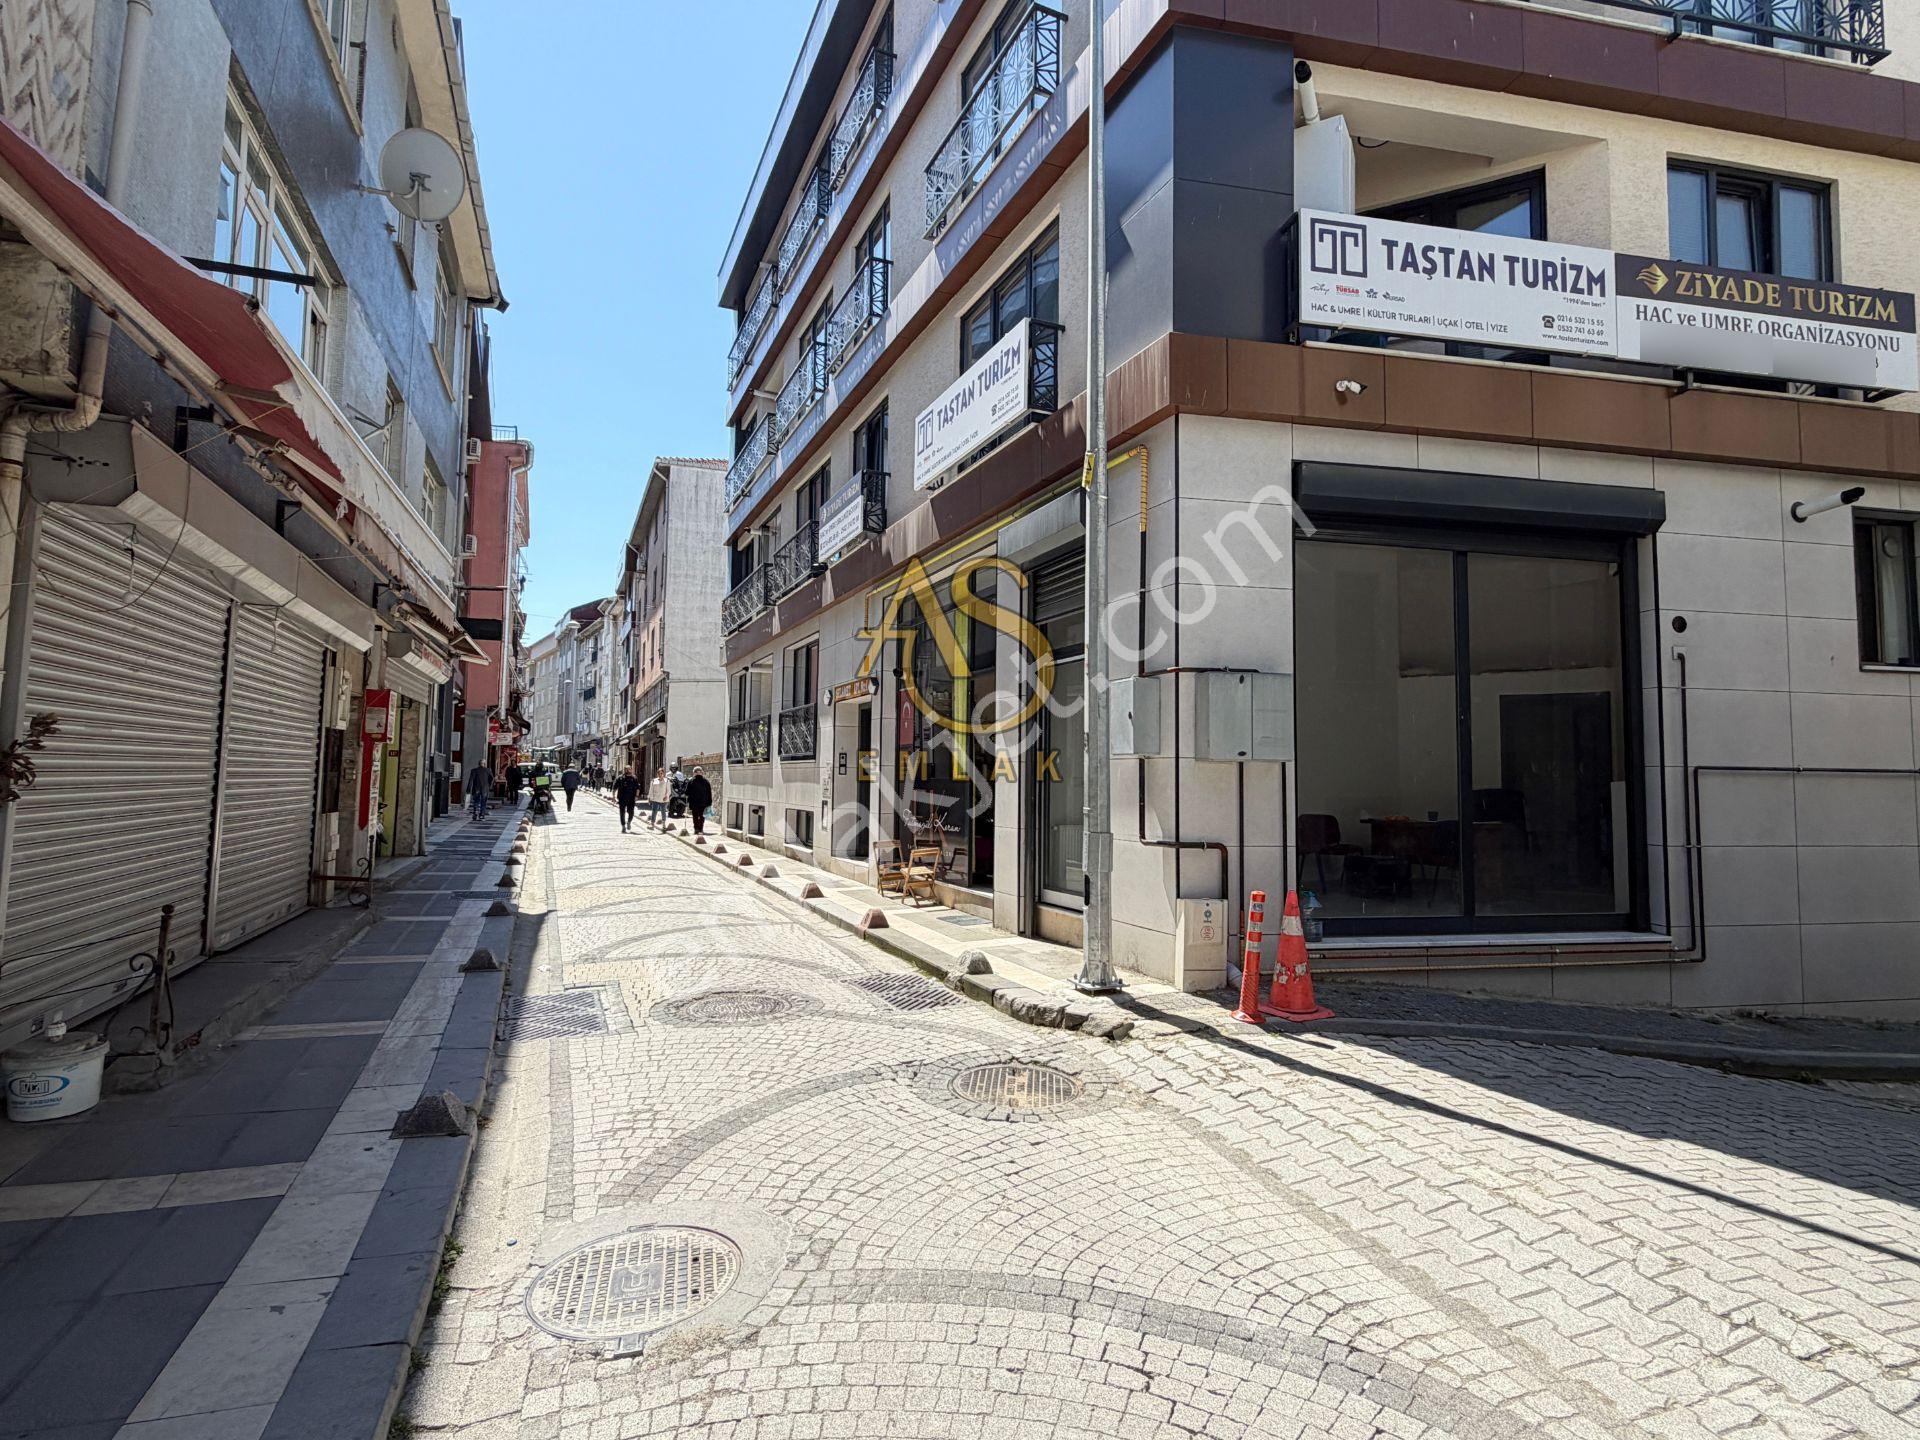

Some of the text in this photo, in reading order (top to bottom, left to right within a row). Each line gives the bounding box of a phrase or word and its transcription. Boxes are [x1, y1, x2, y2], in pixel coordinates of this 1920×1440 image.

[1381, 238, 1607, 297] TAŞTAN TURİZM
[1311, 303, 1328, 313] HAC
[1337, 305, 1361, 316] UMRE
[1437, 317, 1459, 329] UÇAK
[1465, 320, 1485, 331] OTEL
[1557, 315, 1573, 323] 0216
[1574, 316, 1586, 325] 532
[1587, 318, 1595, 326] 15
[1674, 270, 1899, 323] ZİYADE TURİZM
[1635, 303, 1900, 353] HAC ve UMRE ORGANİZASYONU
[936, 380, 976, 432] TAŞTAN
[977, 338, 1021, 398] TURİZM
